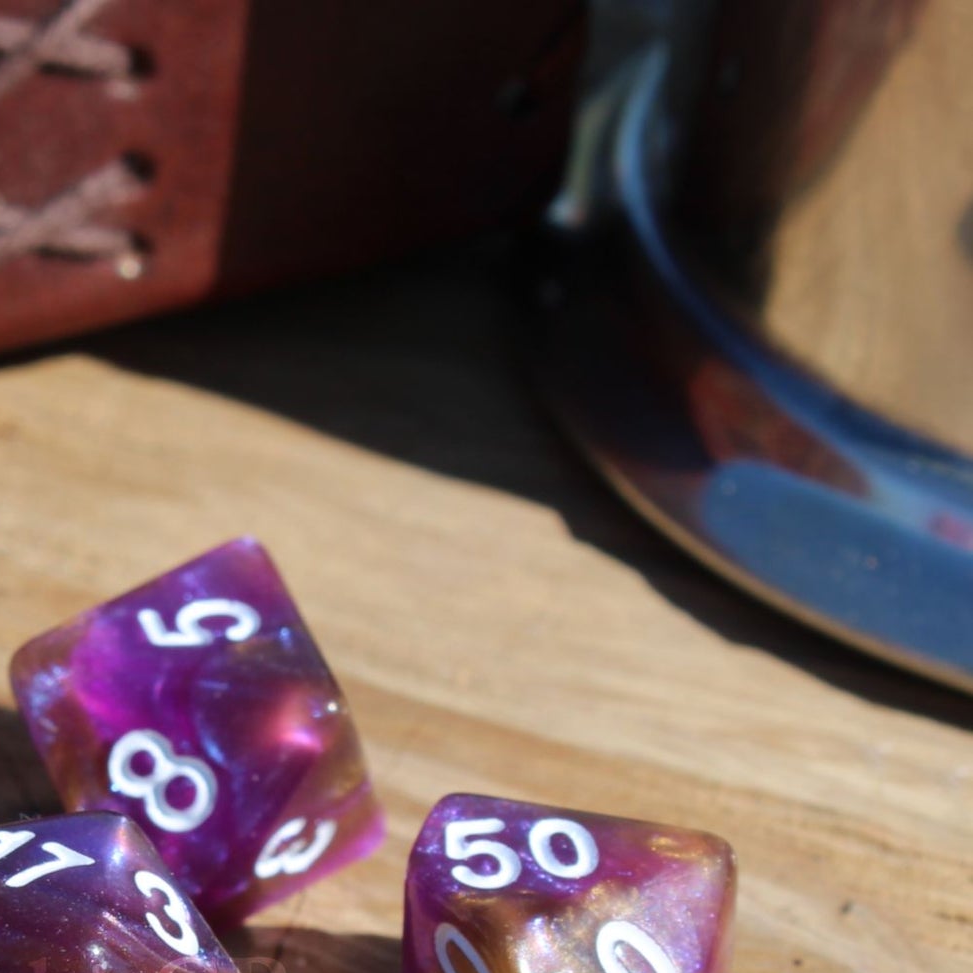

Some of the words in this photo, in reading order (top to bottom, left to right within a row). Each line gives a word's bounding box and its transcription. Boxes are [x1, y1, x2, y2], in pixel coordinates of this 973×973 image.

[108, 728, 218, 833] 8
[444, 817, 600, 890] 50
[133, 870, 201, 956] 3
